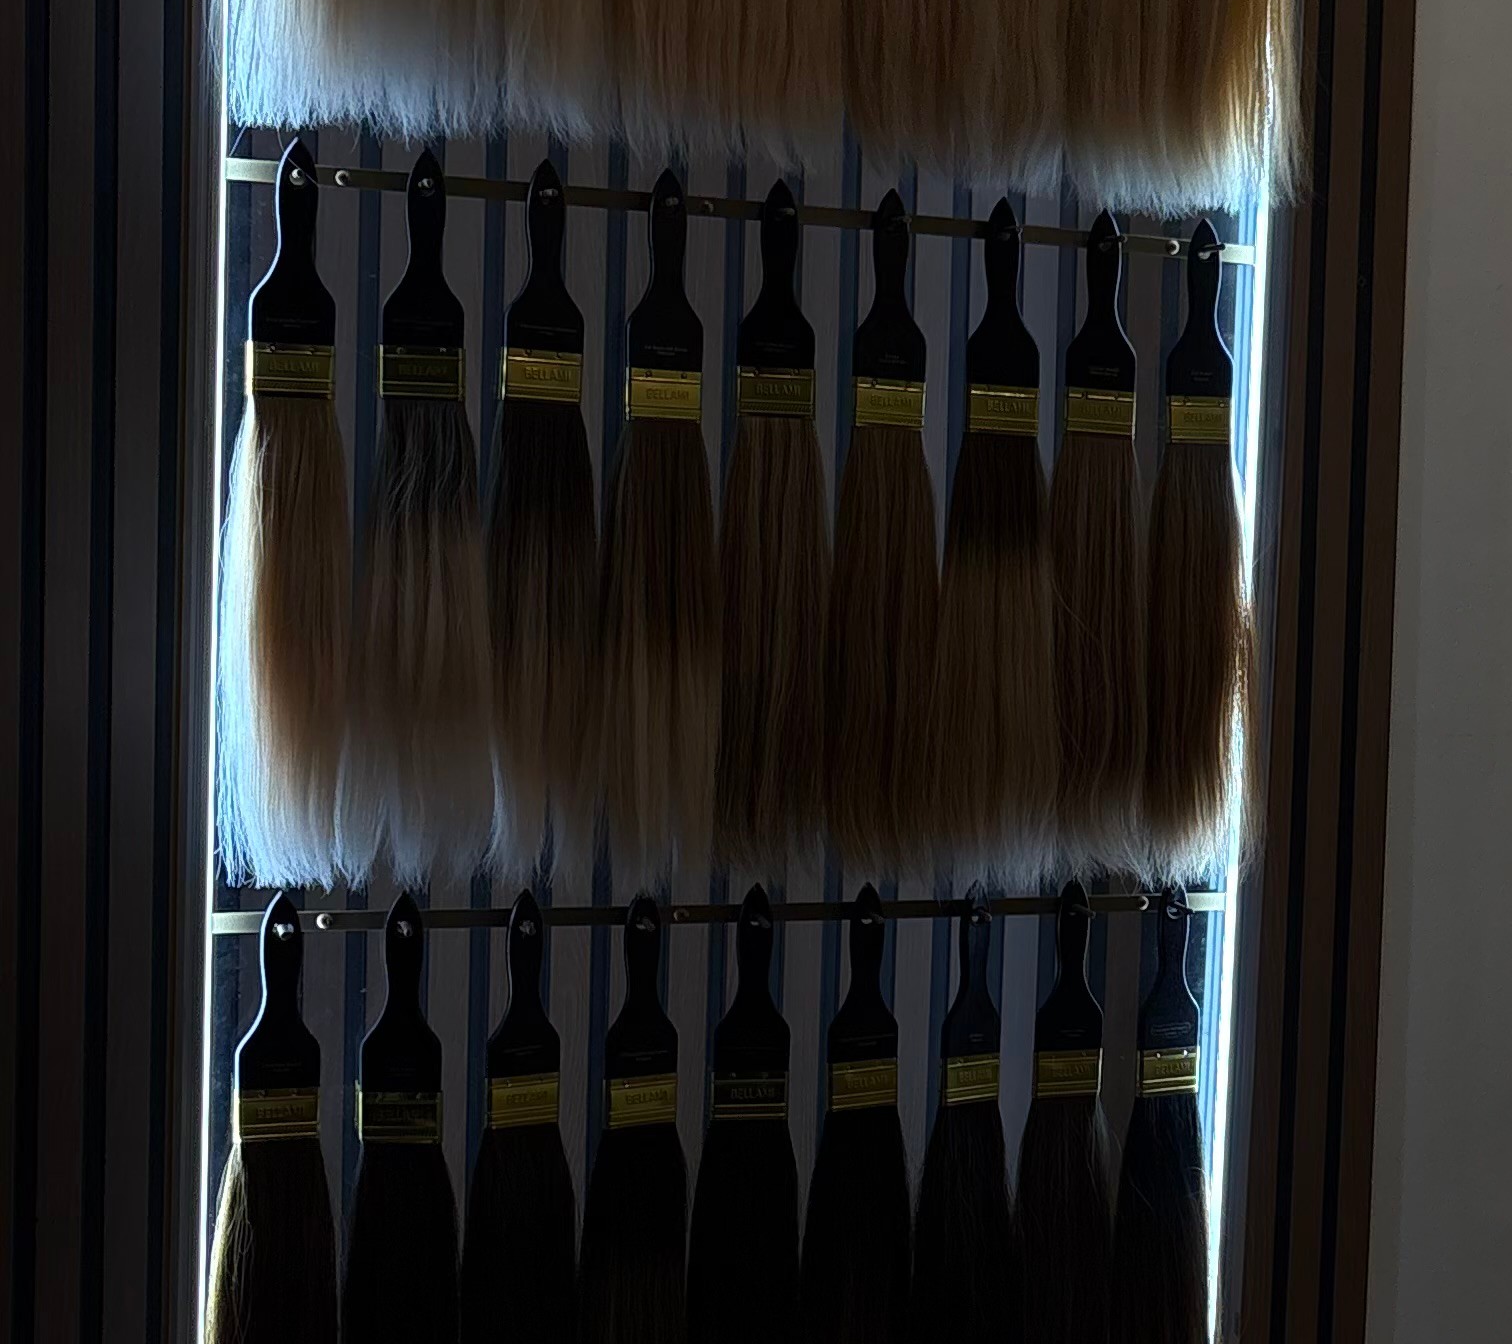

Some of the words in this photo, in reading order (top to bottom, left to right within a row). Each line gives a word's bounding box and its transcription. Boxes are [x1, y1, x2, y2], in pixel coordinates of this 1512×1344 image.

[525, 367, 572, 382] BELLAMI
[645, 388, 689, 401] BELLAMI
[755, 383, 801, 398] BELLAMI
[869, 395, 912, 408] BELLAMI
